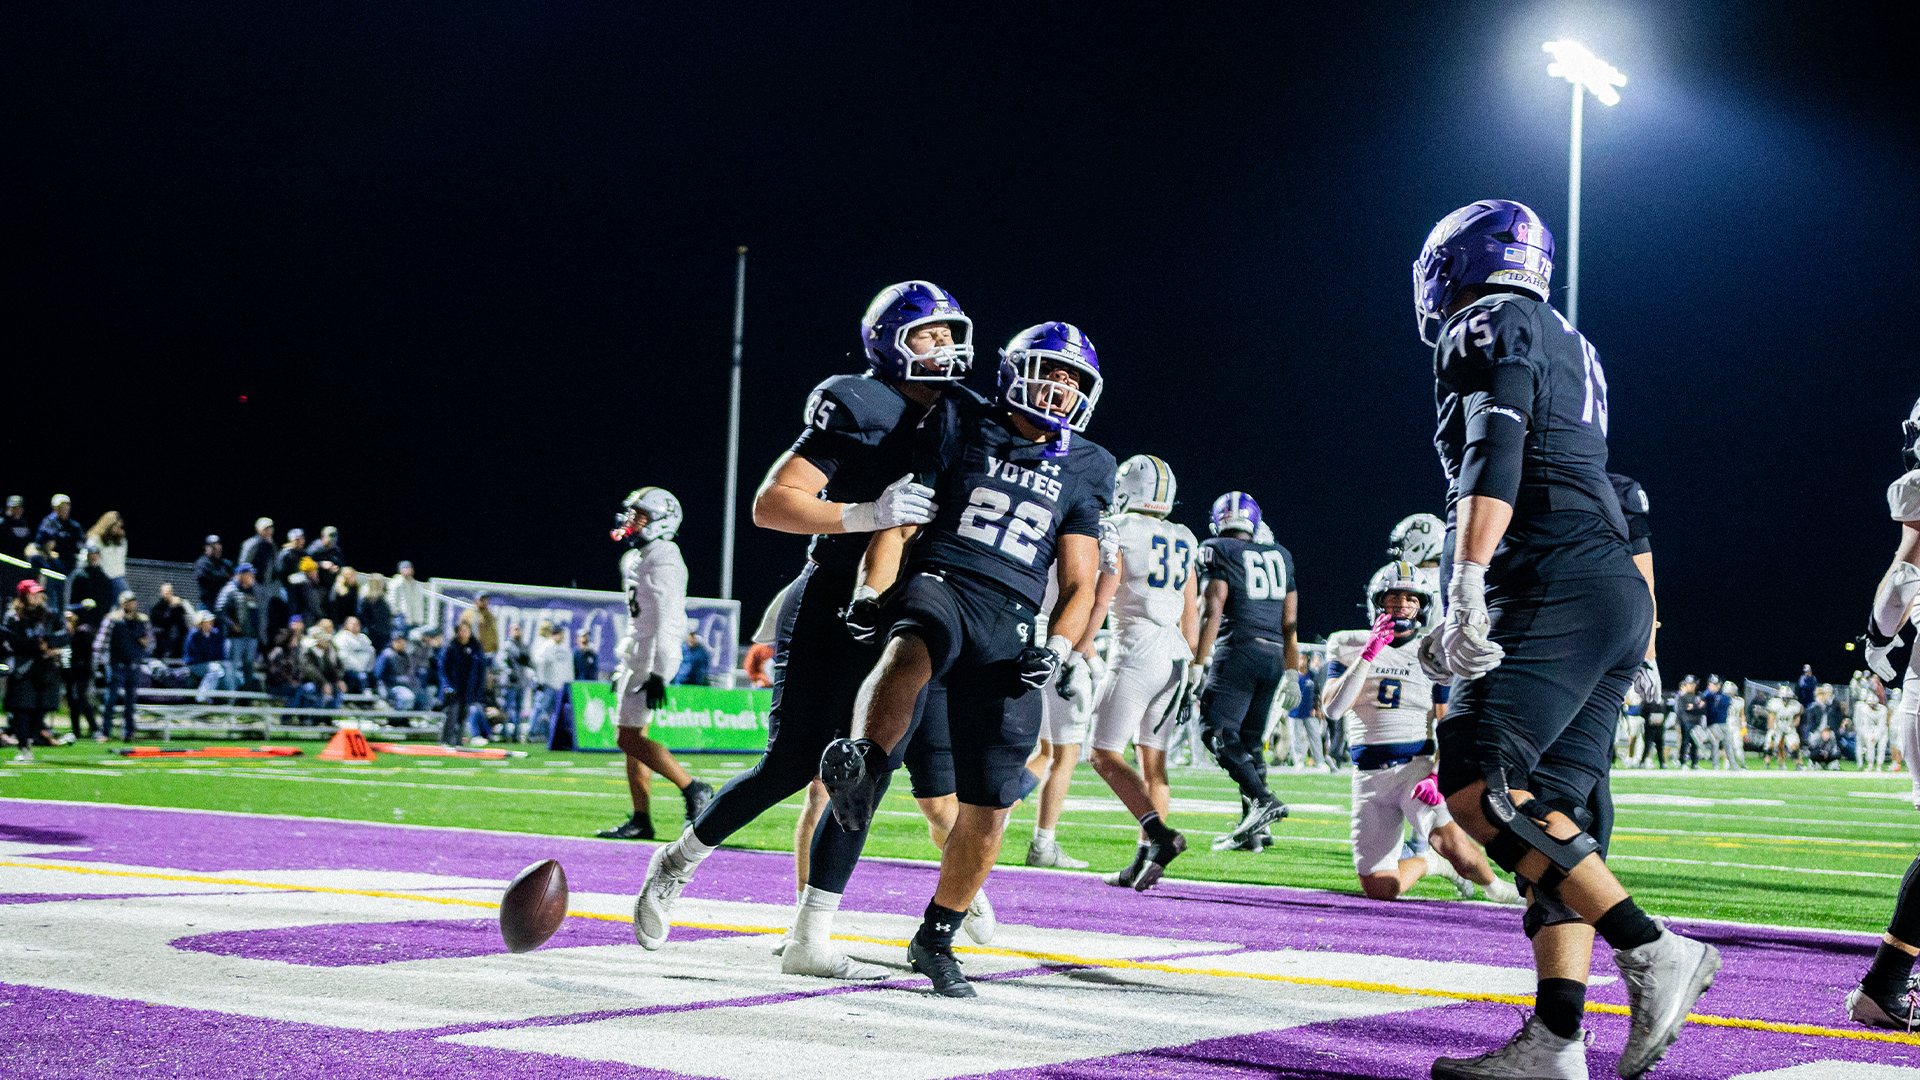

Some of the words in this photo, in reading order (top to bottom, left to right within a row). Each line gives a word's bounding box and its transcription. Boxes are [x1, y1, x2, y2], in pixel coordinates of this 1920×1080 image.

[1508, 272, 1547, 290] IDAHO
[1449, 310, 1494, 358] 75
[804, 389, 837, 430] 85
[986, 456, 1062, 502] YOTES
[957, 486, 1053, 566] 22
[1147, 534, 1190, 591] 33
[1242, 550, 1287, 600] 60
[1375, 666, 1410, 676] EASTERN
[1377, 677, 1403, 709] 9
[654, 707, 713, 728] Central
[712, 709, 759, 730] Credit
